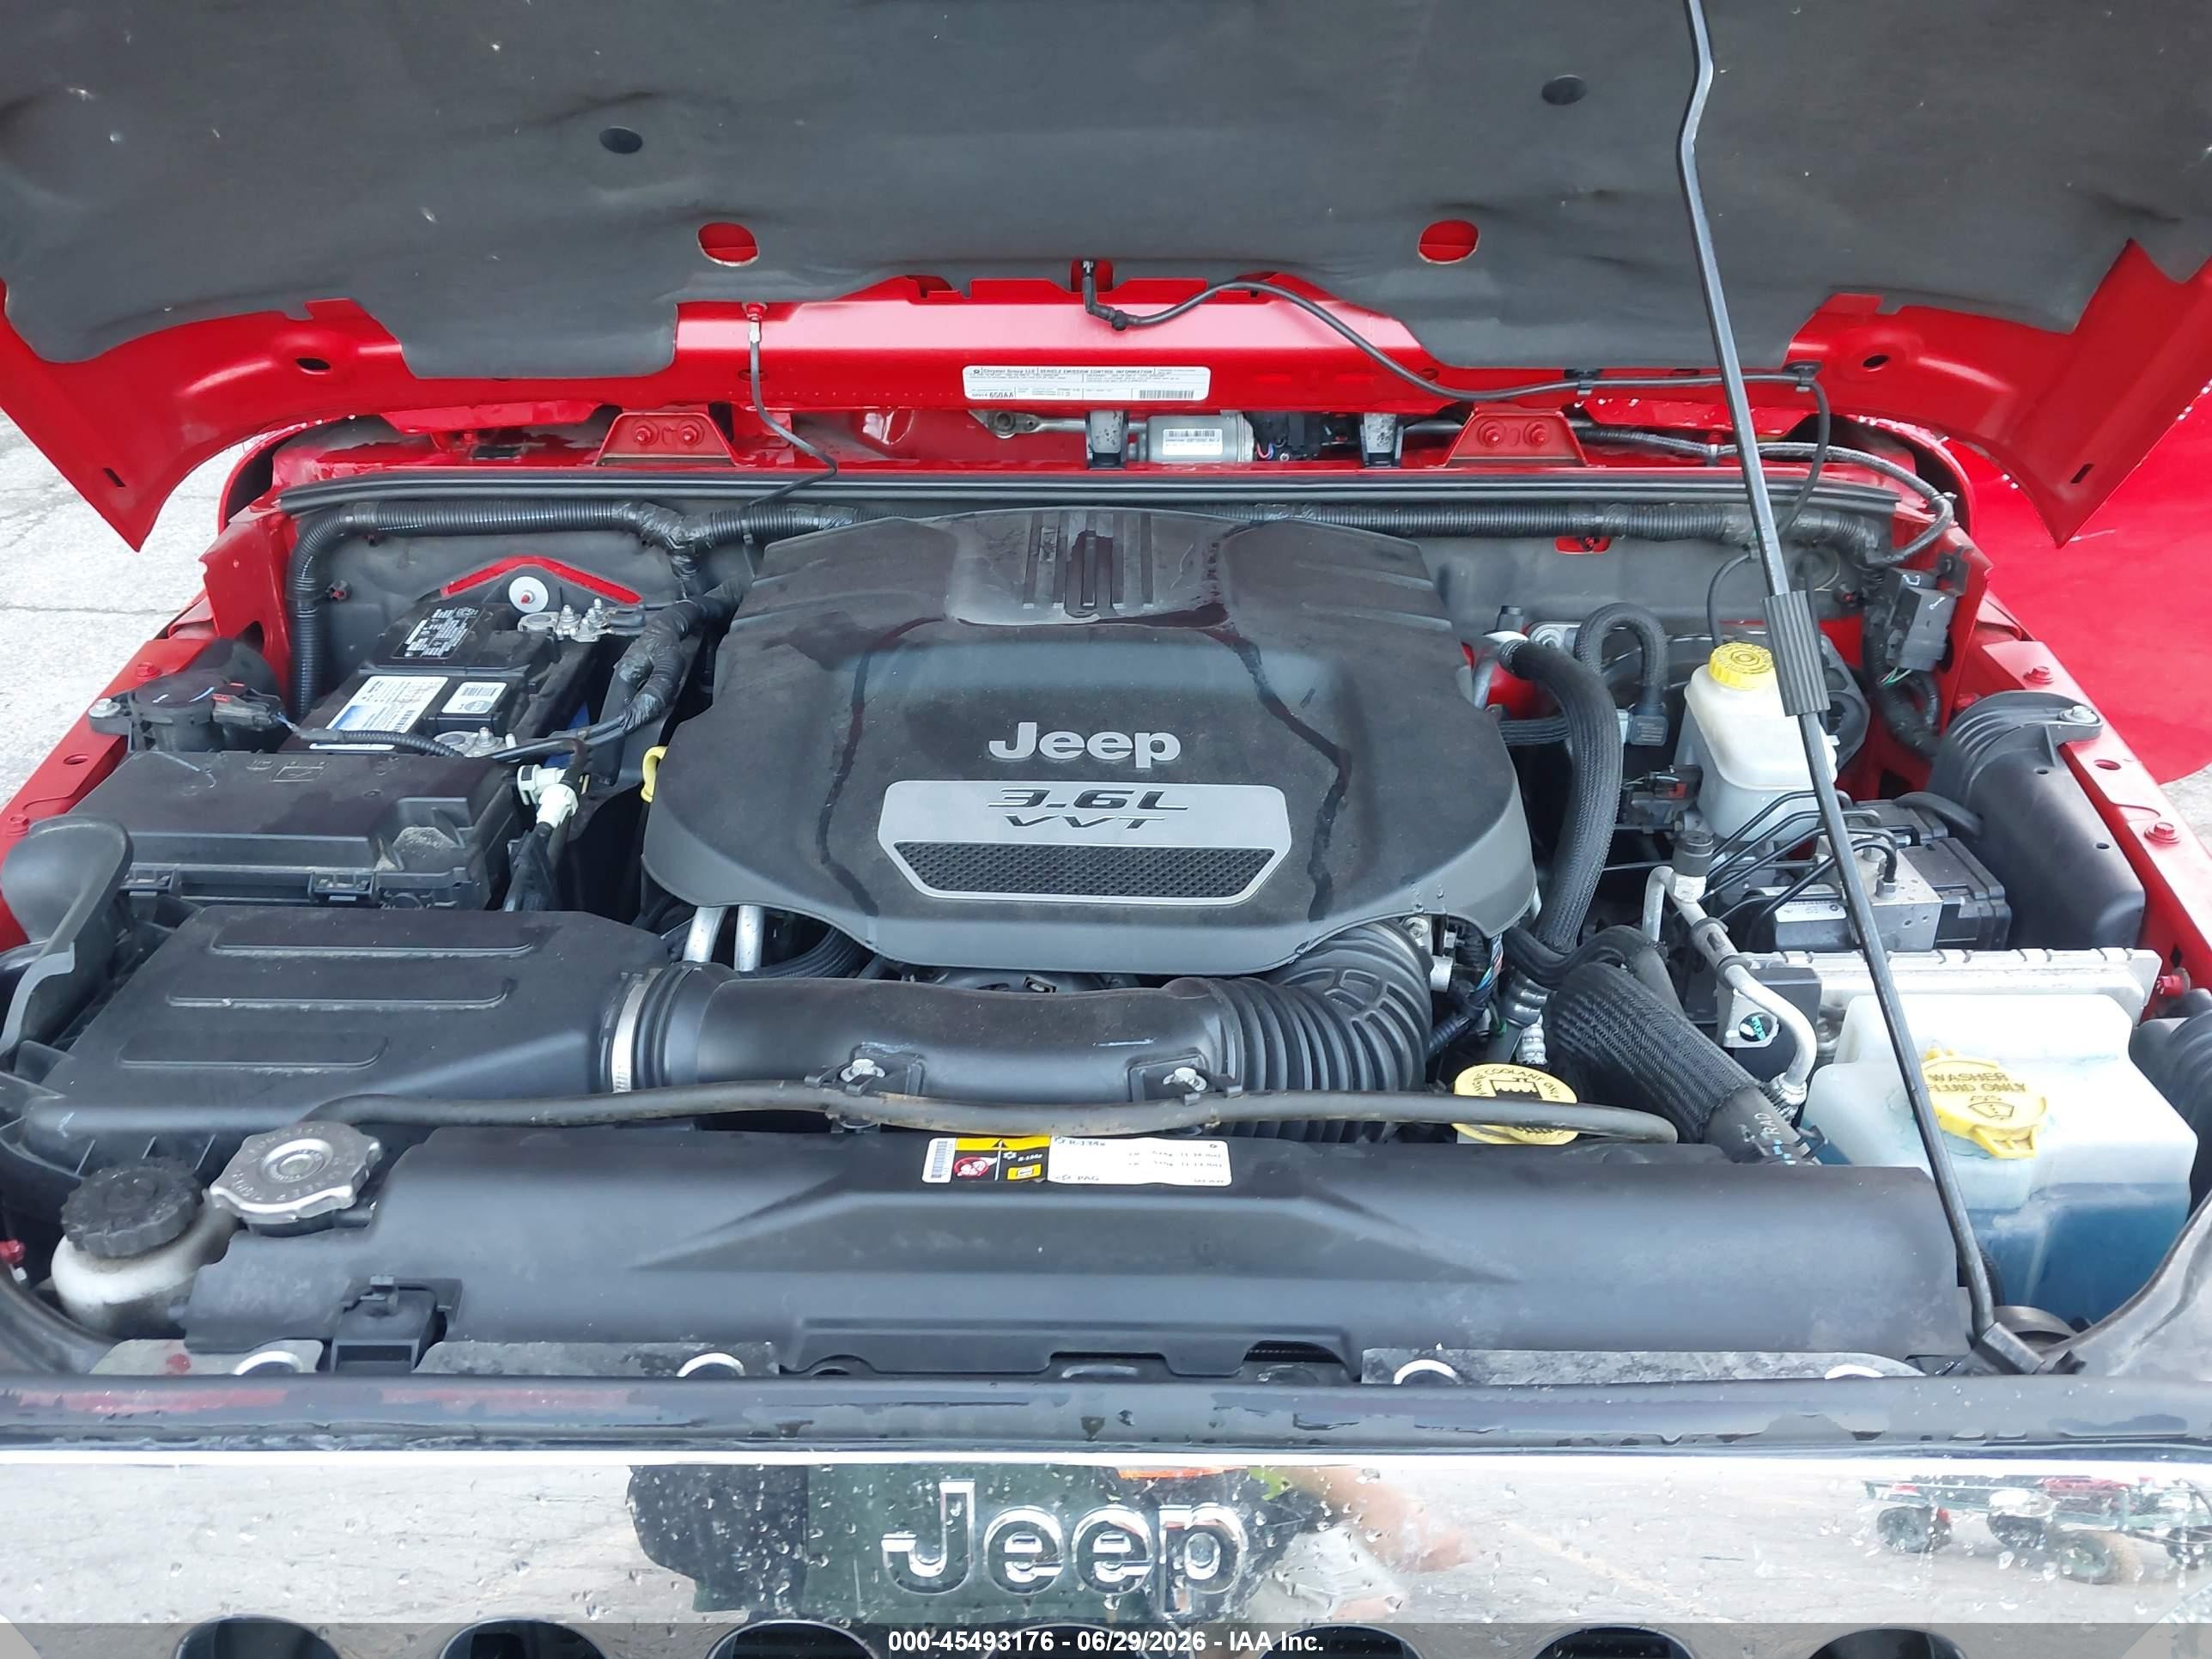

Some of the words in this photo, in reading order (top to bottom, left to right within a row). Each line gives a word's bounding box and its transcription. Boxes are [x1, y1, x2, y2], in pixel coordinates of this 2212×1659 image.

[988, 721, 1182, 769] Jeep
[988, 788, 1188, 811] 3.6L
[1005, 814, 1166, 830] VVT
[1928, 1072, 2008, 1082] WASHER
[881, 1478, 1249, 1614] Jeep
